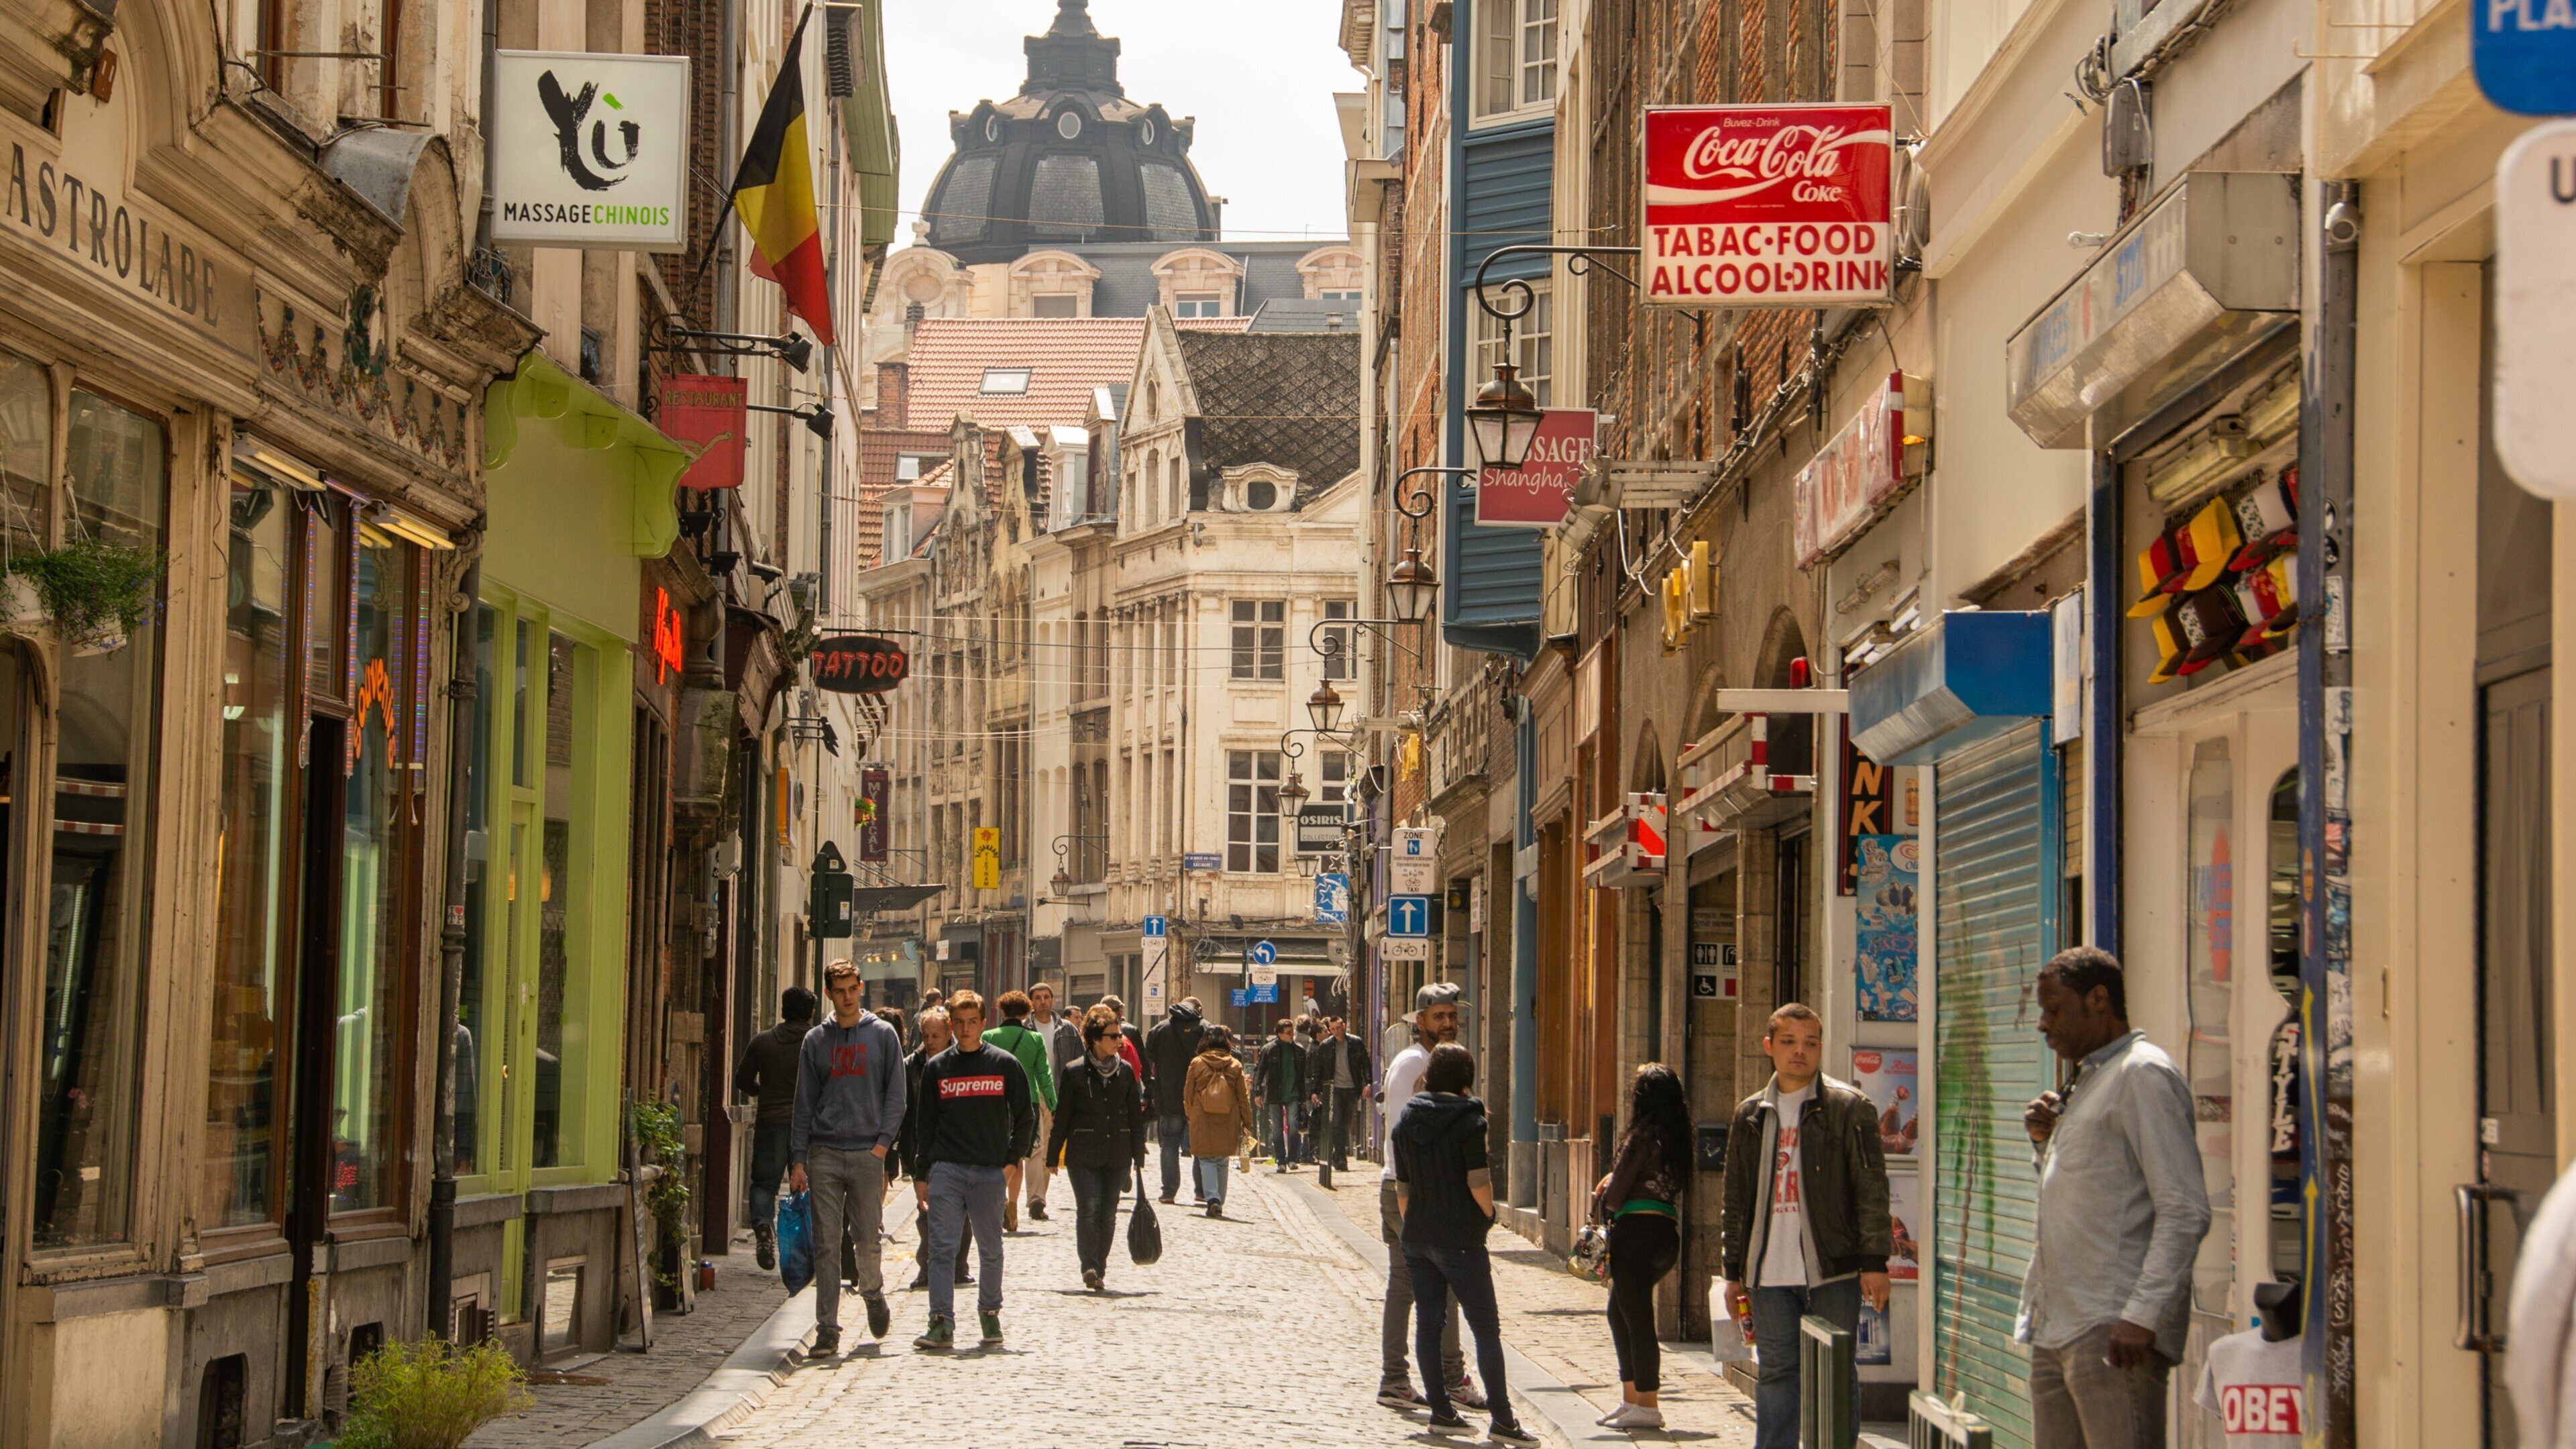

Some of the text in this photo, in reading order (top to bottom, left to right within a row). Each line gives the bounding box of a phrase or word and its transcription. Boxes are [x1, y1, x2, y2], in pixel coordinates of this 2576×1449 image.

[1723, 117, 1780, 127] Buvez-Drink
[1683, 125, 1844, 179] Coca-Cola
[1792, 180, 1842, 202] Coke
[6, 142, 221, 328] ASTROLABE
[665, 390, 743, 408] RESTAURANT
[812, 651, 904, 679] TATTOO
[1300, 816, 1342, 825] OSIRIS
[941, 1079, 1003, 1097] Supreme
[2271, 1022, 2300, 1152] STYLE
